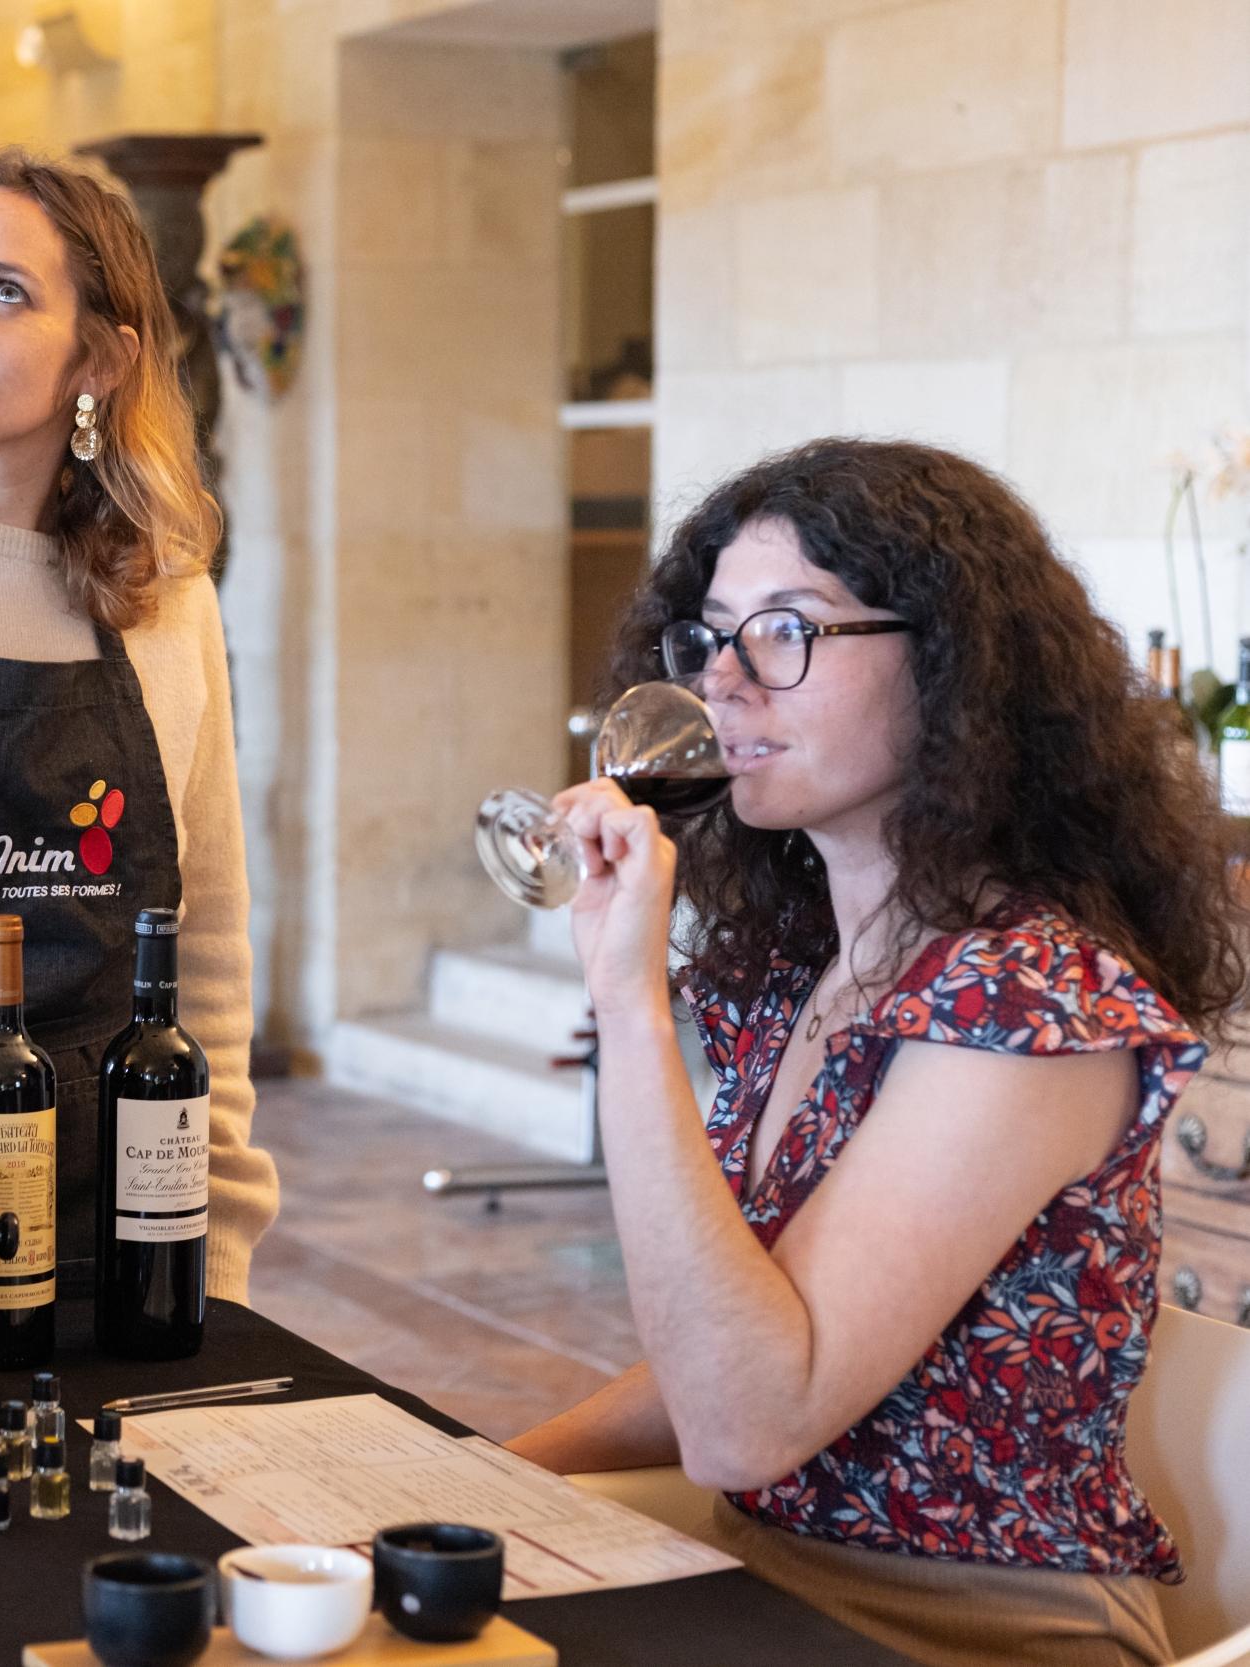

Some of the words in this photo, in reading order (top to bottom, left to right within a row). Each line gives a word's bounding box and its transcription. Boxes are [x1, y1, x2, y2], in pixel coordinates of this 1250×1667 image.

[2, 885, 48, 899] TOUTES
[51, 884, 70, 897] SES
[159, 1134, 201, 1146] CHÂTEAU
[125, 1145, 152, 1159] CAP
[156, 1149, 174, 1160] DE
[139, 1162, 175, 1175] Grand
